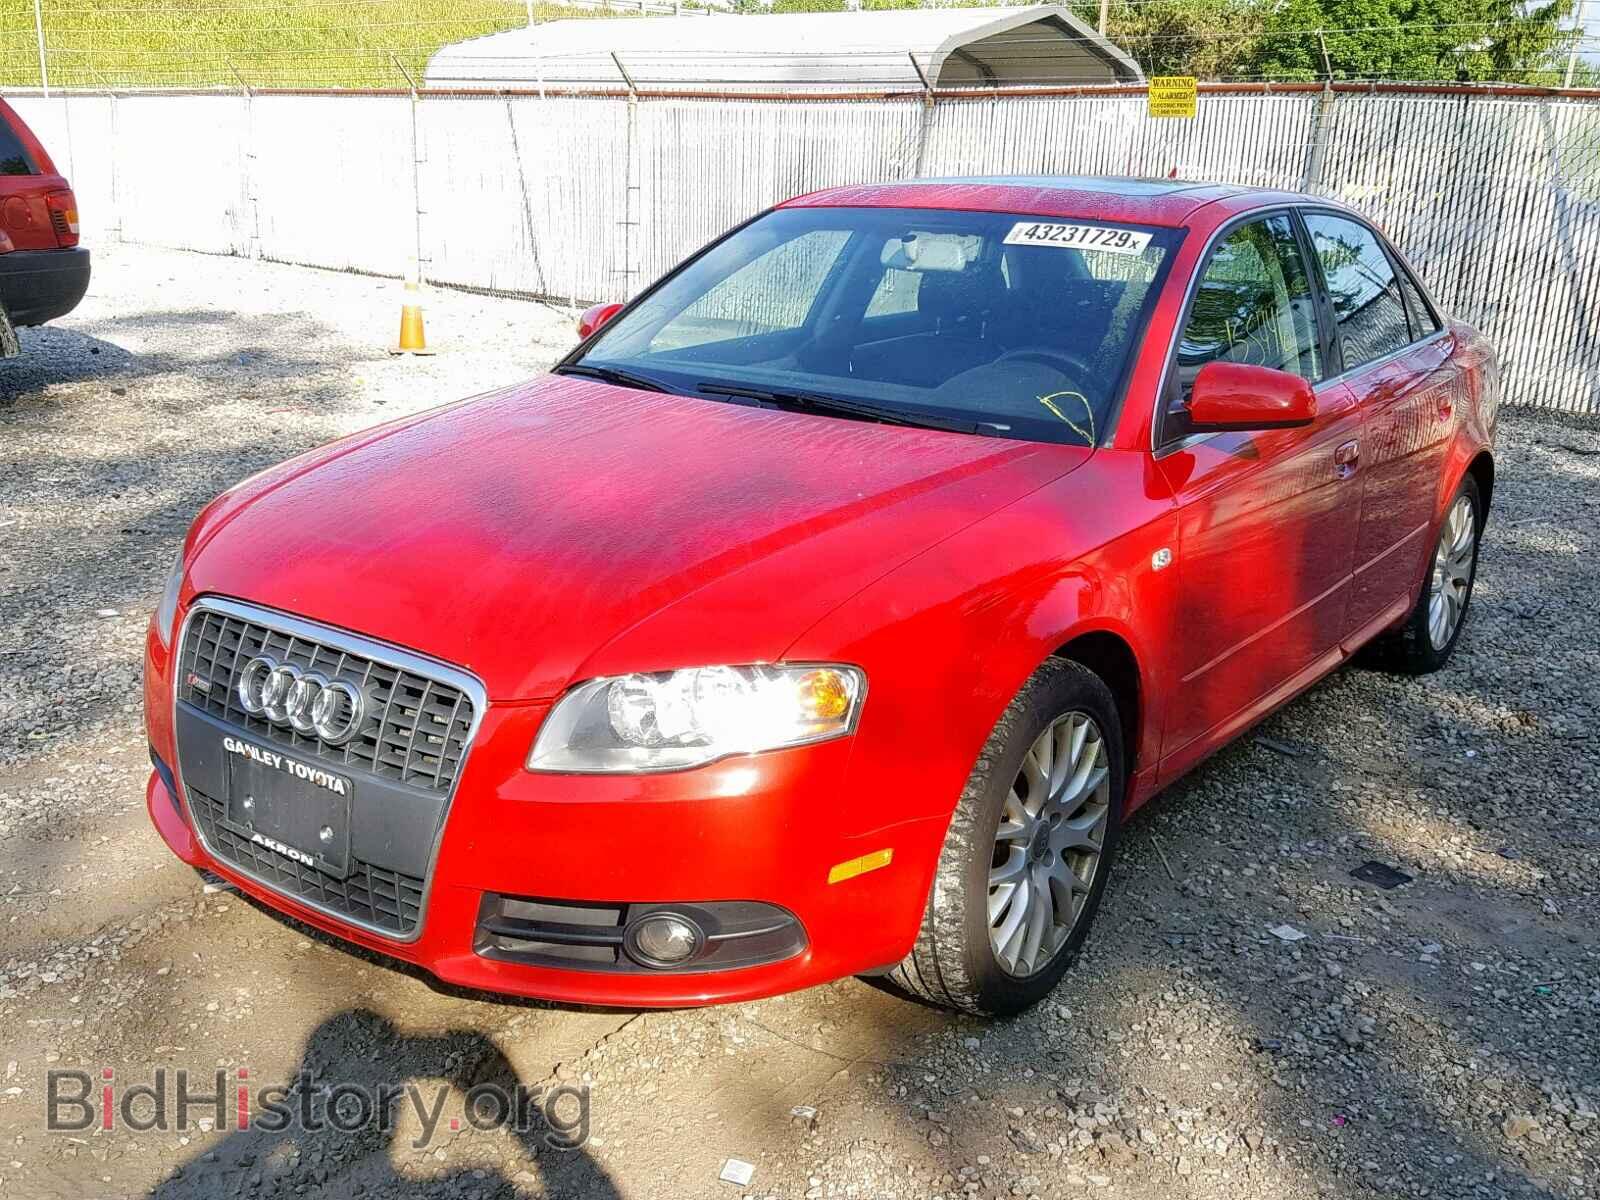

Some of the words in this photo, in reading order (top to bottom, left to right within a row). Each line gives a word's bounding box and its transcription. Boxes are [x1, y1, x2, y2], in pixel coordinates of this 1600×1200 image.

[1153, 79, 1193, 88] WARNING
[223, 737, 282, 770] GANLEY
[285, 759, 346, 796] TOYOTA
[250, 833, 314, 867] AKRON
